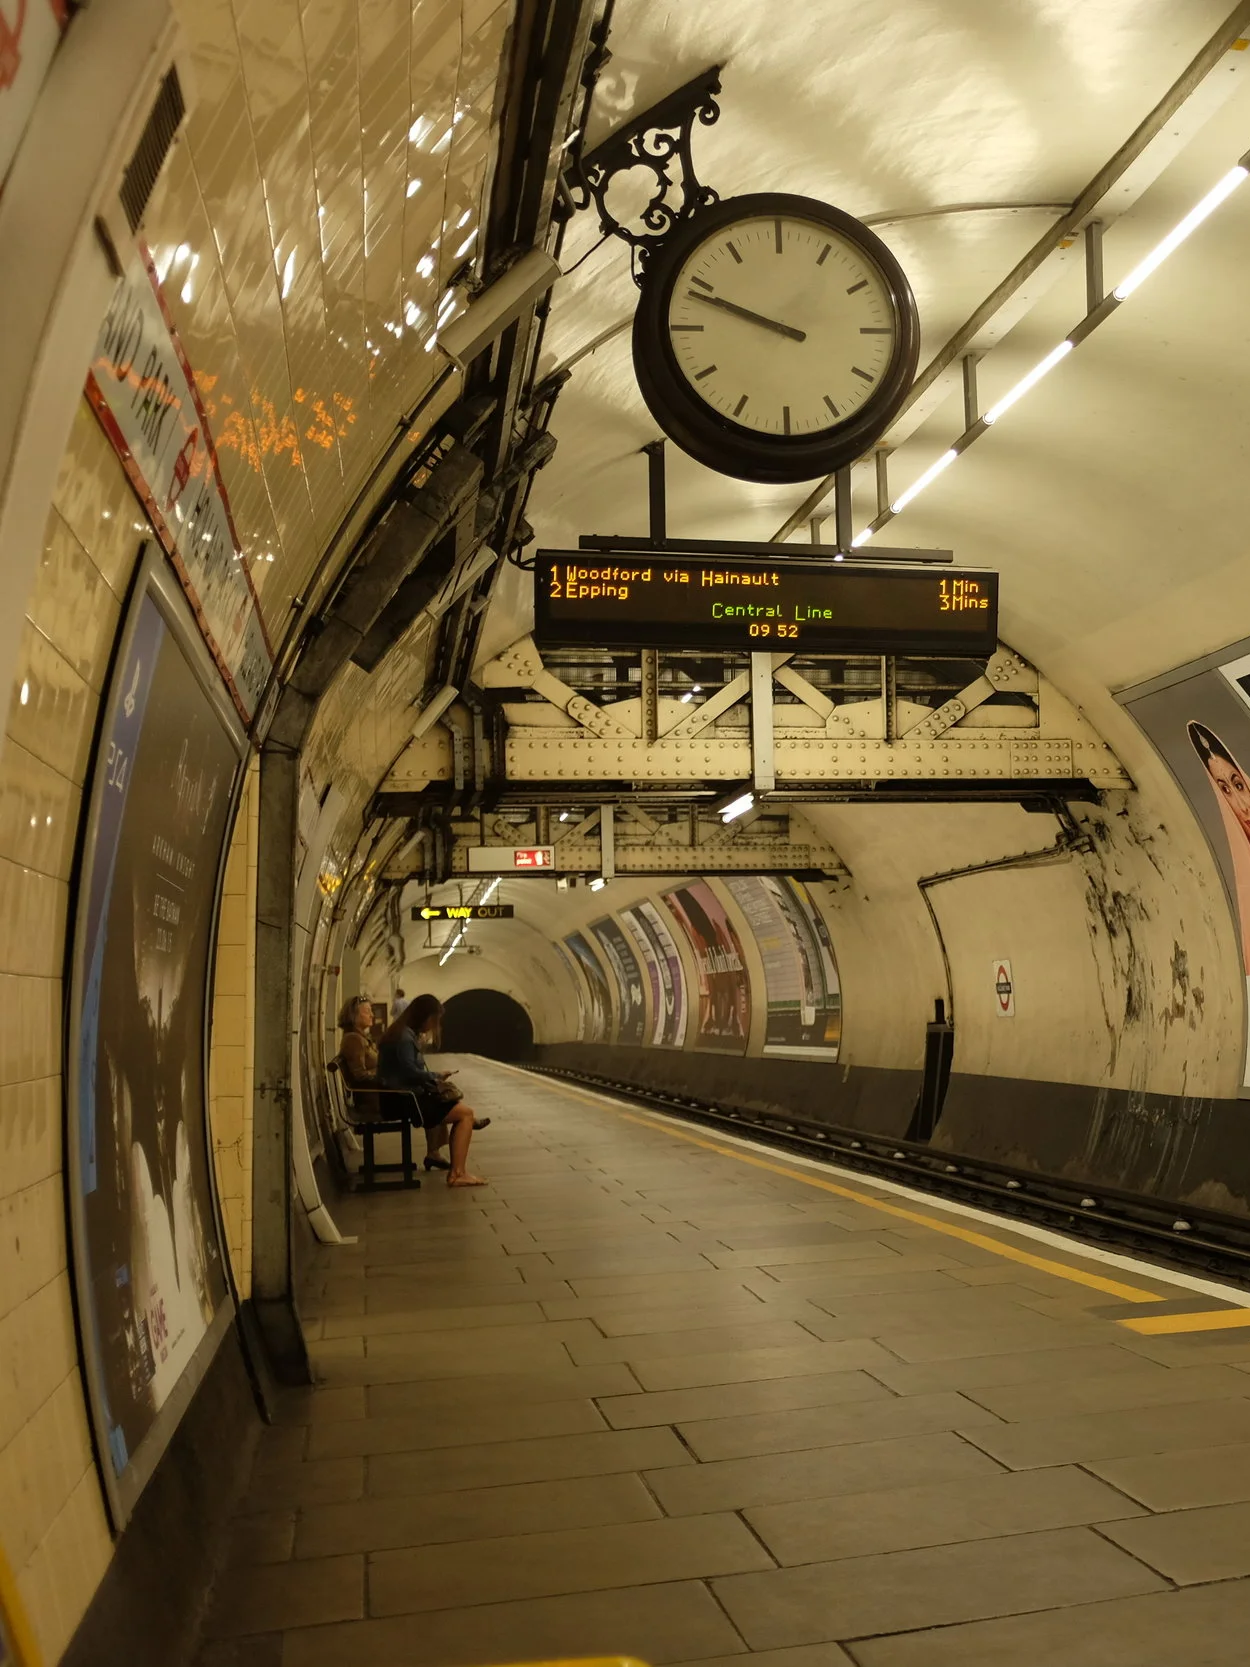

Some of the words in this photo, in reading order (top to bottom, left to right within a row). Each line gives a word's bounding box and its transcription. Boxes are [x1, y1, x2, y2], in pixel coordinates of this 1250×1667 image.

[550, 565, 559, 583] 1
[566, 566, 651, 583] Woodford
[664, 567, 690, 583] via
[701, 571, 779, 586] Hainault
[550, 583, 561, 598] 2
[566, 582, 628, 599] Epping
[940, 579, 948, 594] 1
[952, 580, 979, 595] Min
[940, 595, 950, 610] 3
[952, 595, 988, 610] Mins
[712, 603, 782, 619] Central
[795, 606, 833, 620] Line
[749, 624, 769, 638] 09
[777, 624, 799, 638] 52
[447, 907, 472, 918] WAY
[478, 907, 504, 917] OUT
